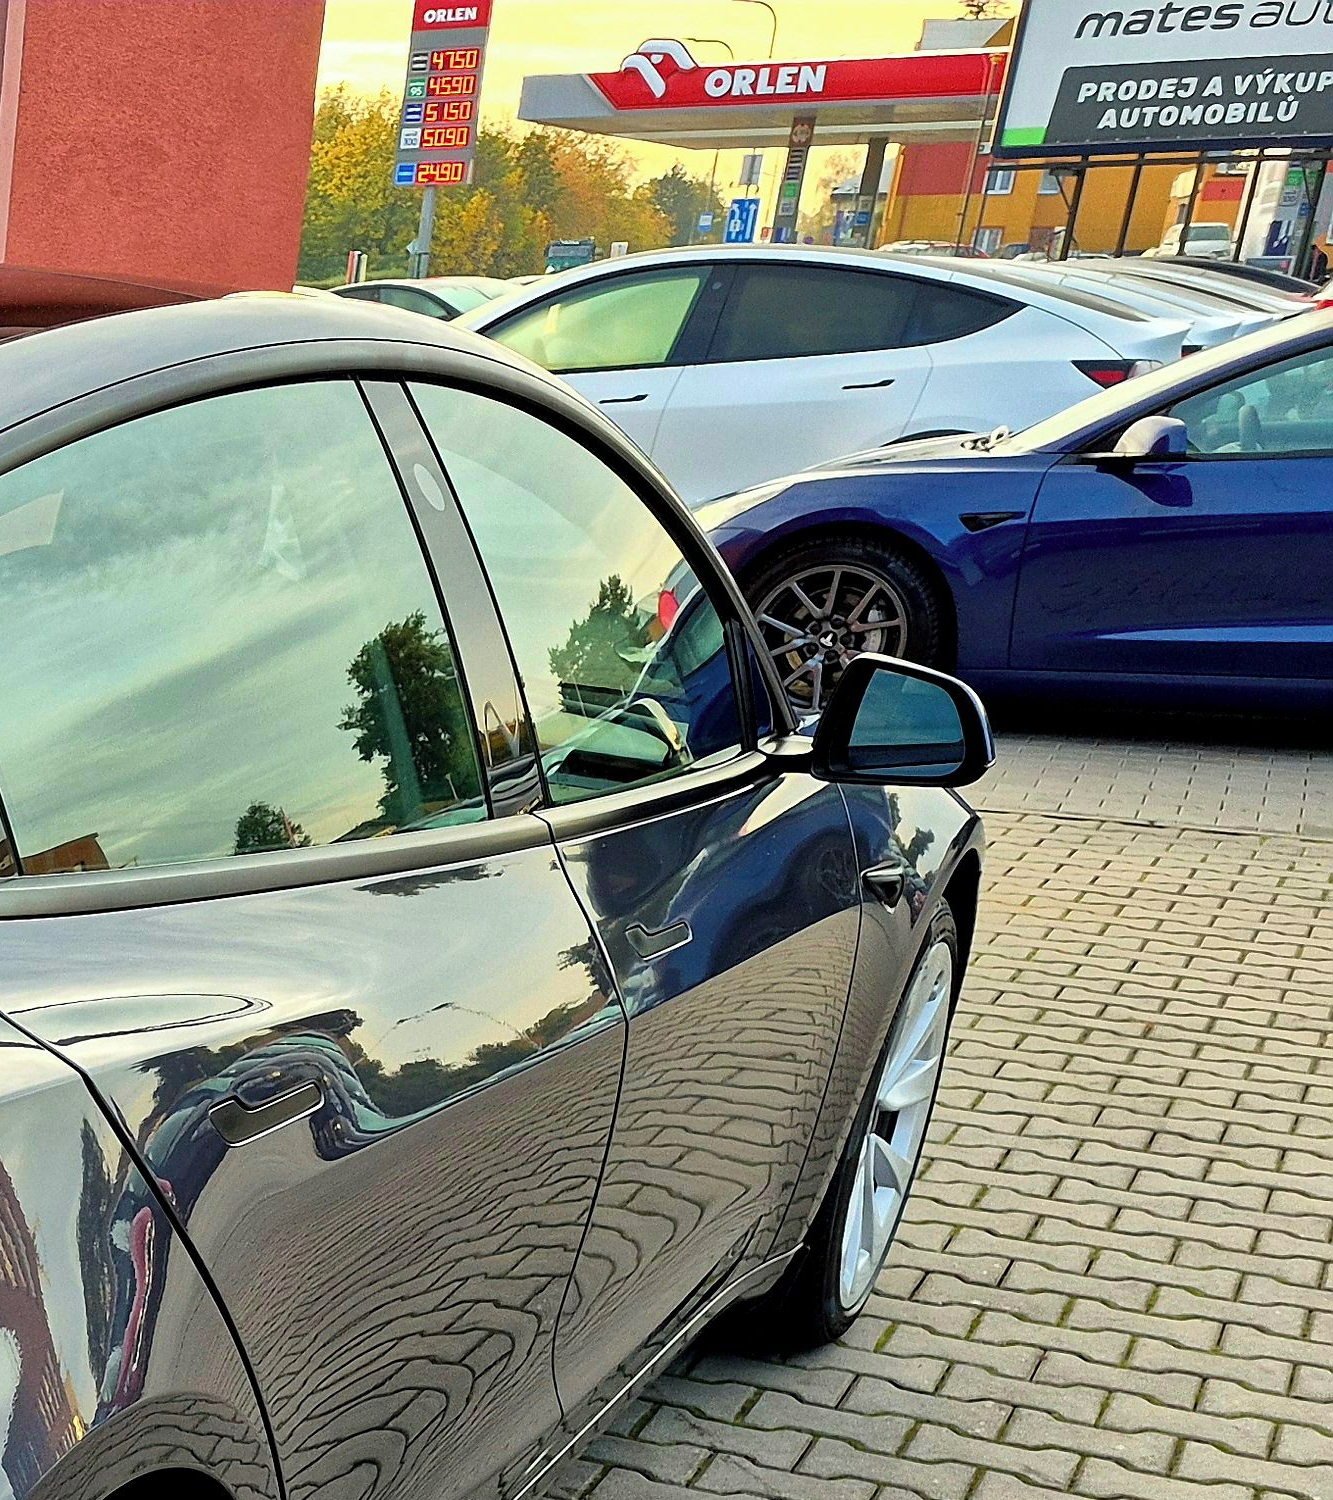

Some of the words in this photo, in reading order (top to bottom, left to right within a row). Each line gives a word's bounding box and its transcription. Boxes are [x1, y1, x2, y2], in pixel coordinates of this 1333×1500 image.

[423, 7, 478, 24] ORLEN
[1074, 1, 1244, 39] mates
[704, 65, 827, 97] ORLEN
[1076, 76, 1198, 103] PRODEJ
[1201, 76, 1223, 97] A
[1234, 68, 1333, 96] VÝKUP
[1096, 95, 1300, 129] AUTOMOBILŮ
